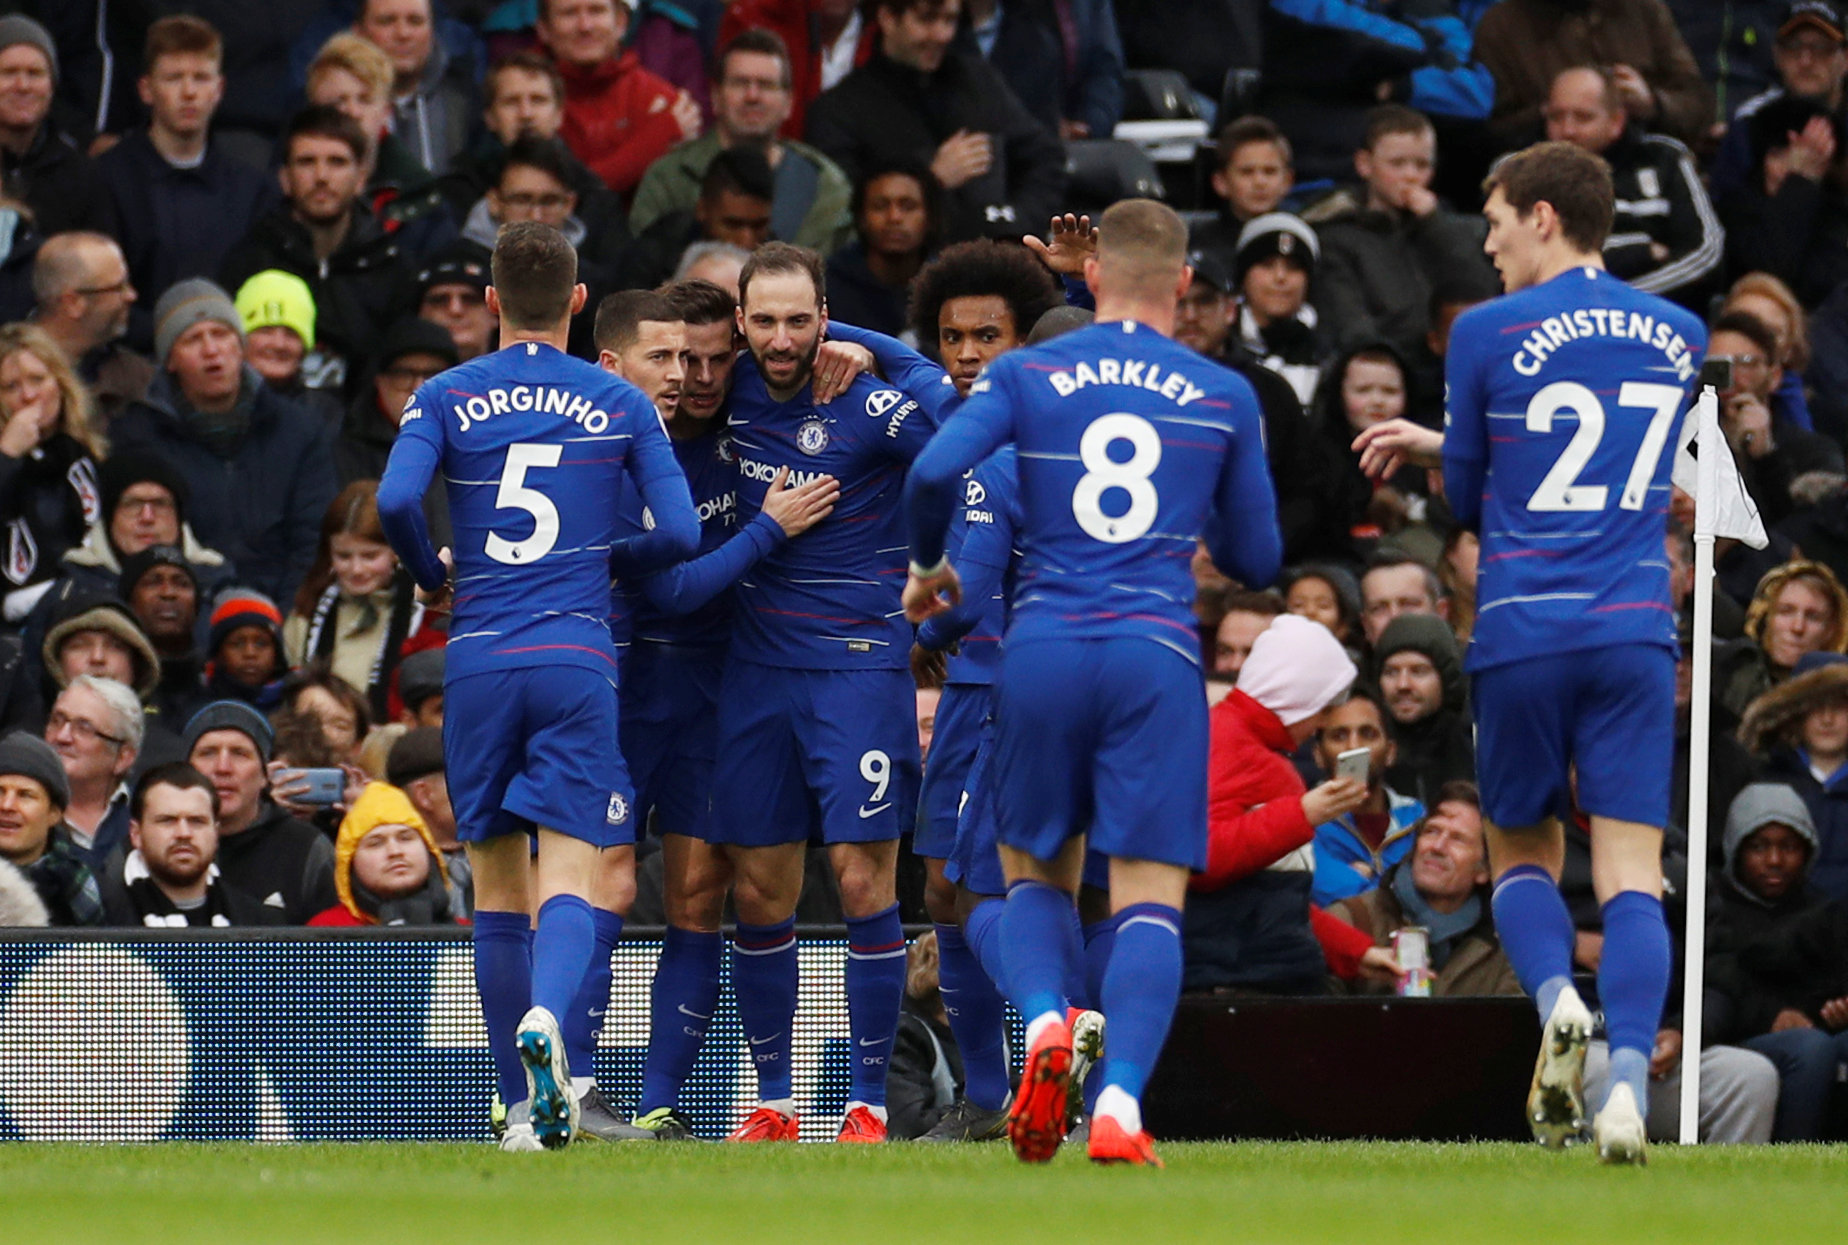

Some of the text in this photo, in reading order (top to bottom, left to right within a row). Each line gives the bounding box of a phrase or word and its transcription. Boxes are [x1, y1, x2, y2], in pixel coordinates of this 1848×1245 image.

[1049, 358, 1205, 407] BARKLEY
[453, 386, 609, 434] JORGINHO
[1526, 381, 1684, 511] 27
[1072, 412, 1162, 543] 8
[485, 443, 563, 565] 5
[860, 750, 891, 801] 9
[756, 1052, 779, 1062] CFC
[862, 1056, 884, 1066] CFC
